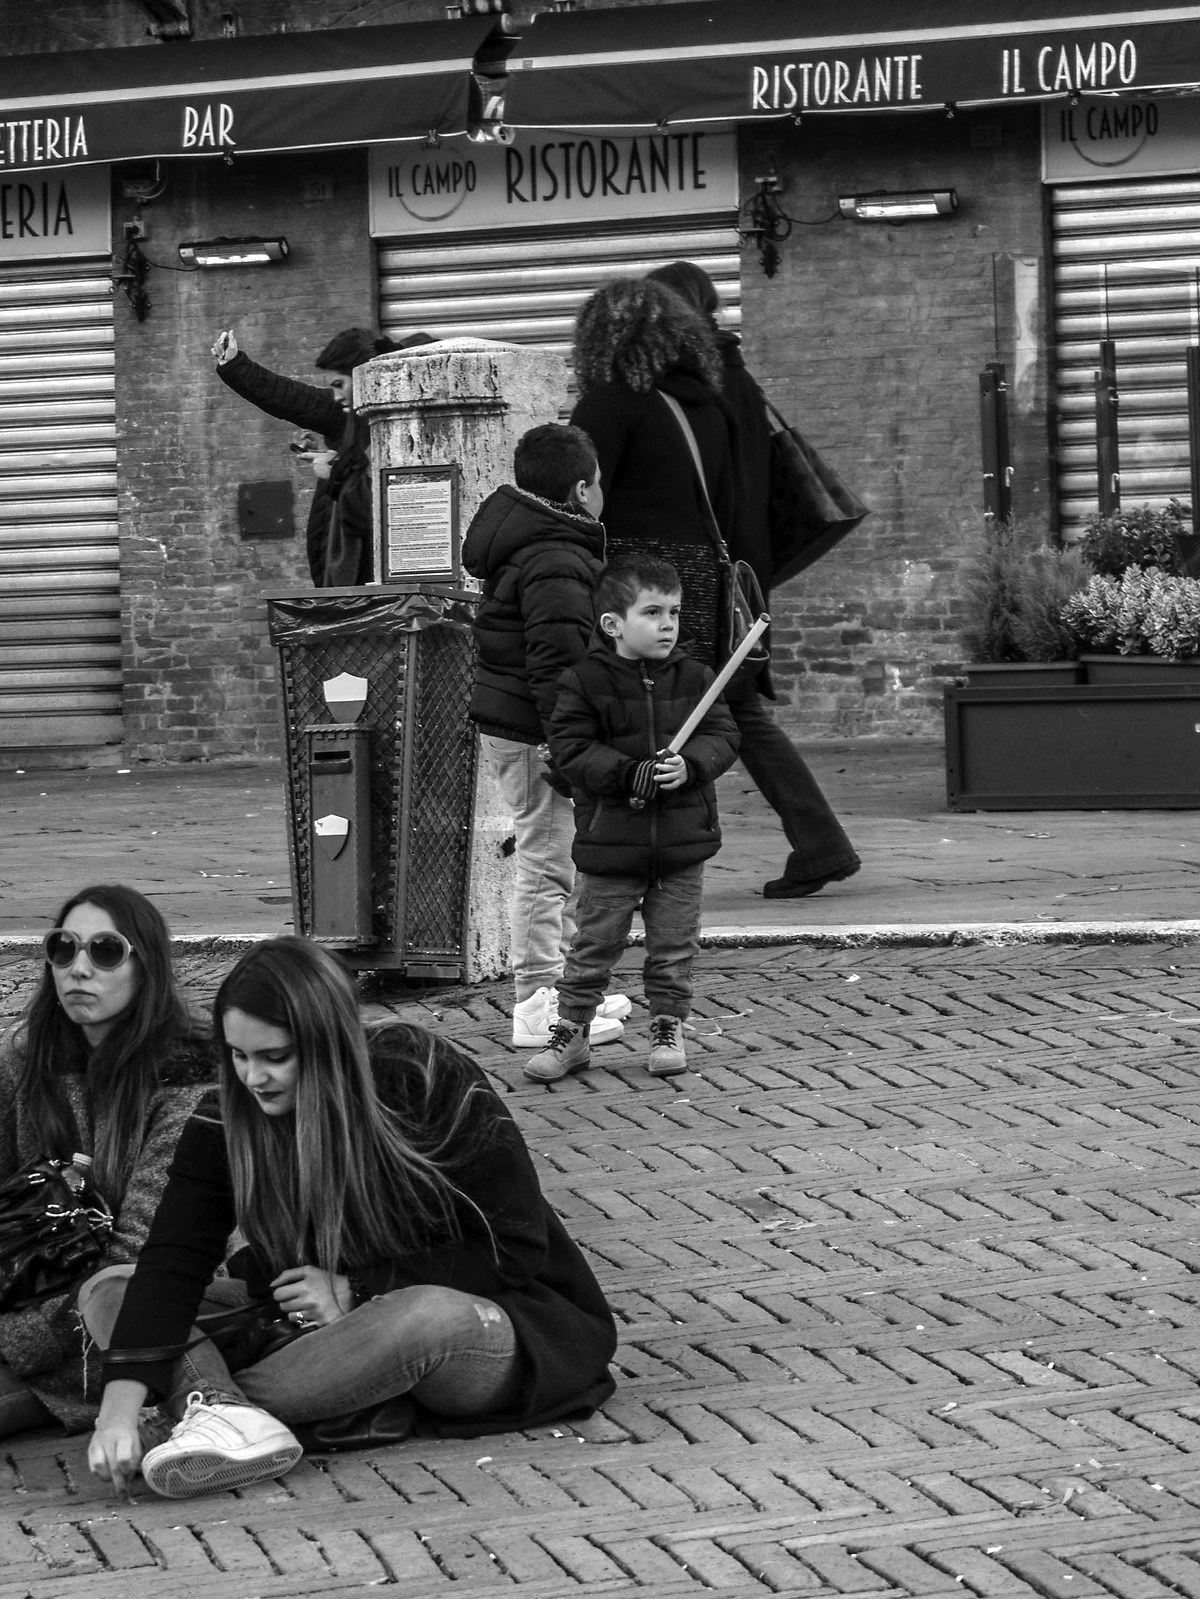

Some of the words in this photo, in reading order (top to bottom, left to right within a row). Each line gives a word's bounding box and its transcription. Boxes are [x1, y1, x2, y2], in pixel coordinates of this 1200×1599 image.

[752, 54, 924, 110] RISTORANTE
[1002, 48, 1026, 94] IL
[1037, 39, 1137, 92] CAMPO
[182, 103, 237, 148] BAR
[1060, 109, 1078, 142] IL
[1086, 102, 1159, 140] CAMPO
[387, 166, 404, 198] IL
[411, 160, 477, 196] CAMPO
[504, 131, 709, 204] RISTORANTE
